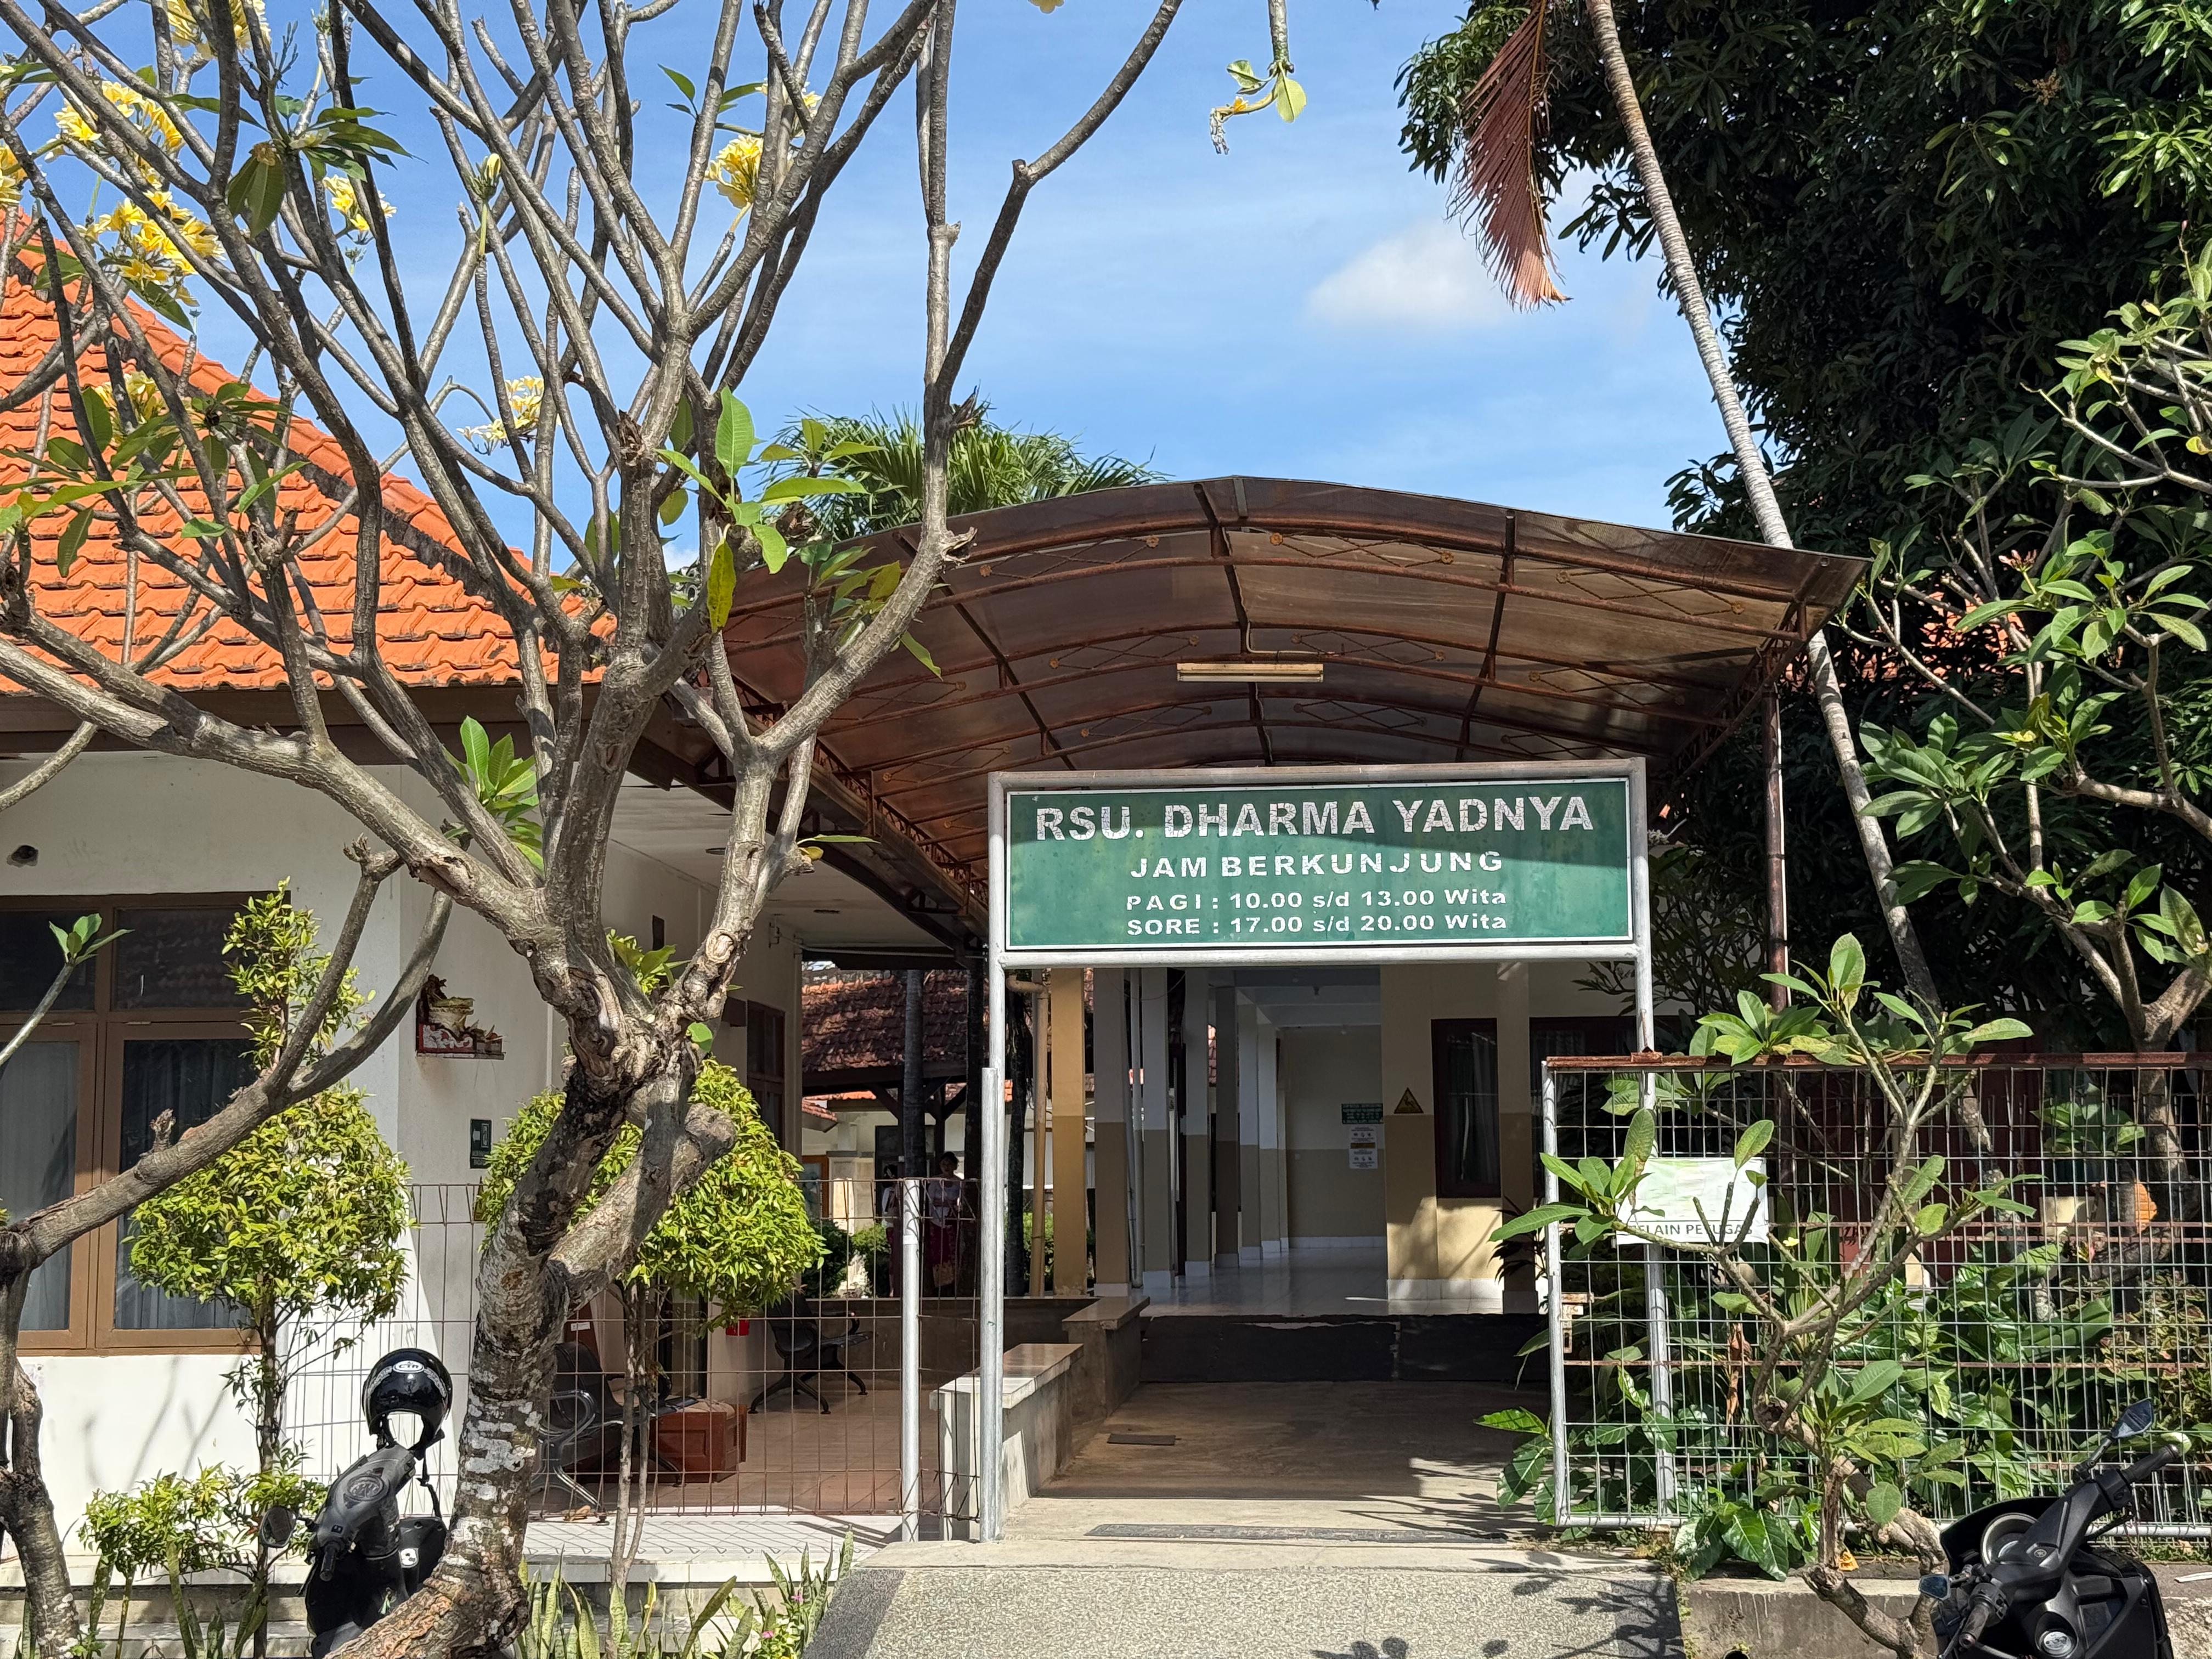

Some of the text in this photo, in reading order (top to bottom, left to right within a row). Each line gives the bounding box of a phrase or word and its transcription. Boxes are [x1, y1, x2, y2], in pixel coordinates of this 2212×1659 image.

[1036, 796, 1594, 840] RSU. DHARMA YADNYA
[1131, 851, 1502, 878] JAM BERKUNJUNG
[1126, 893, 1201, 911] PAGI
[1230, 891, 1303, 909] 10.00
[1313, 890, 1351, 908] s/d
[1361, 889, 1434, 907] 13.00
[1443, 886, 1507, 905] Wita
[1127, 918, 1200, 935] SORE
[1230, 916, 1303, 935] 17.00
[1312, 916, 1350, 933] s/d
[1360, 915, 1434, 932] 20.00
[1443, 912, 1507, 930] Wita
[1628, 1224, 1753, 1235] ELAIN PEUGA
